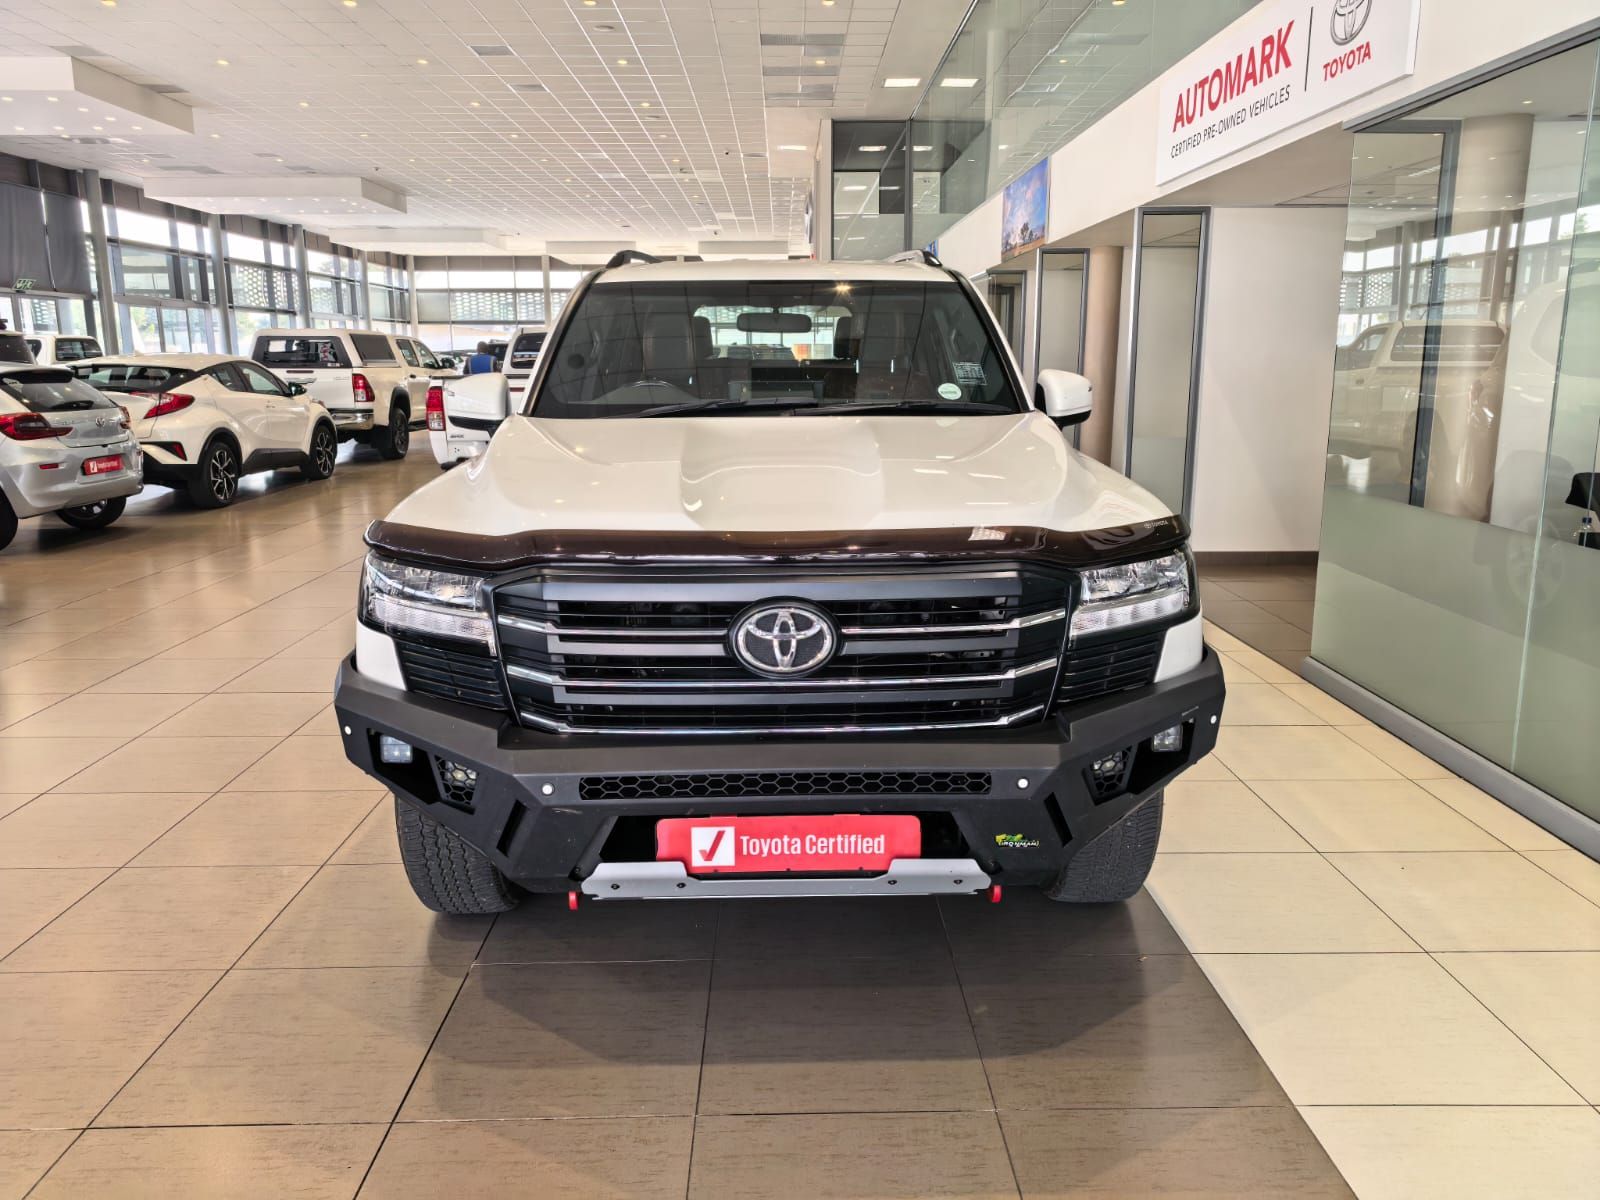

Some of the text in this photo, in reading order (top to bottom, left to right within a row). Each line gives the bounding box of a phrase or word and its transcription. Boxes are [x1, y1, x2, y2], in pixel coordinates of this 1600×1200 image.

[1172, 20, 1295, 133] AUTOMARK
[1323, 41, 1371, 81] TOYOTA
[1170, 84, 1291, 158] CERTIFIED PRE-OWNED VEHICLES
[740, 834, 885, 857] Toyota Certified
